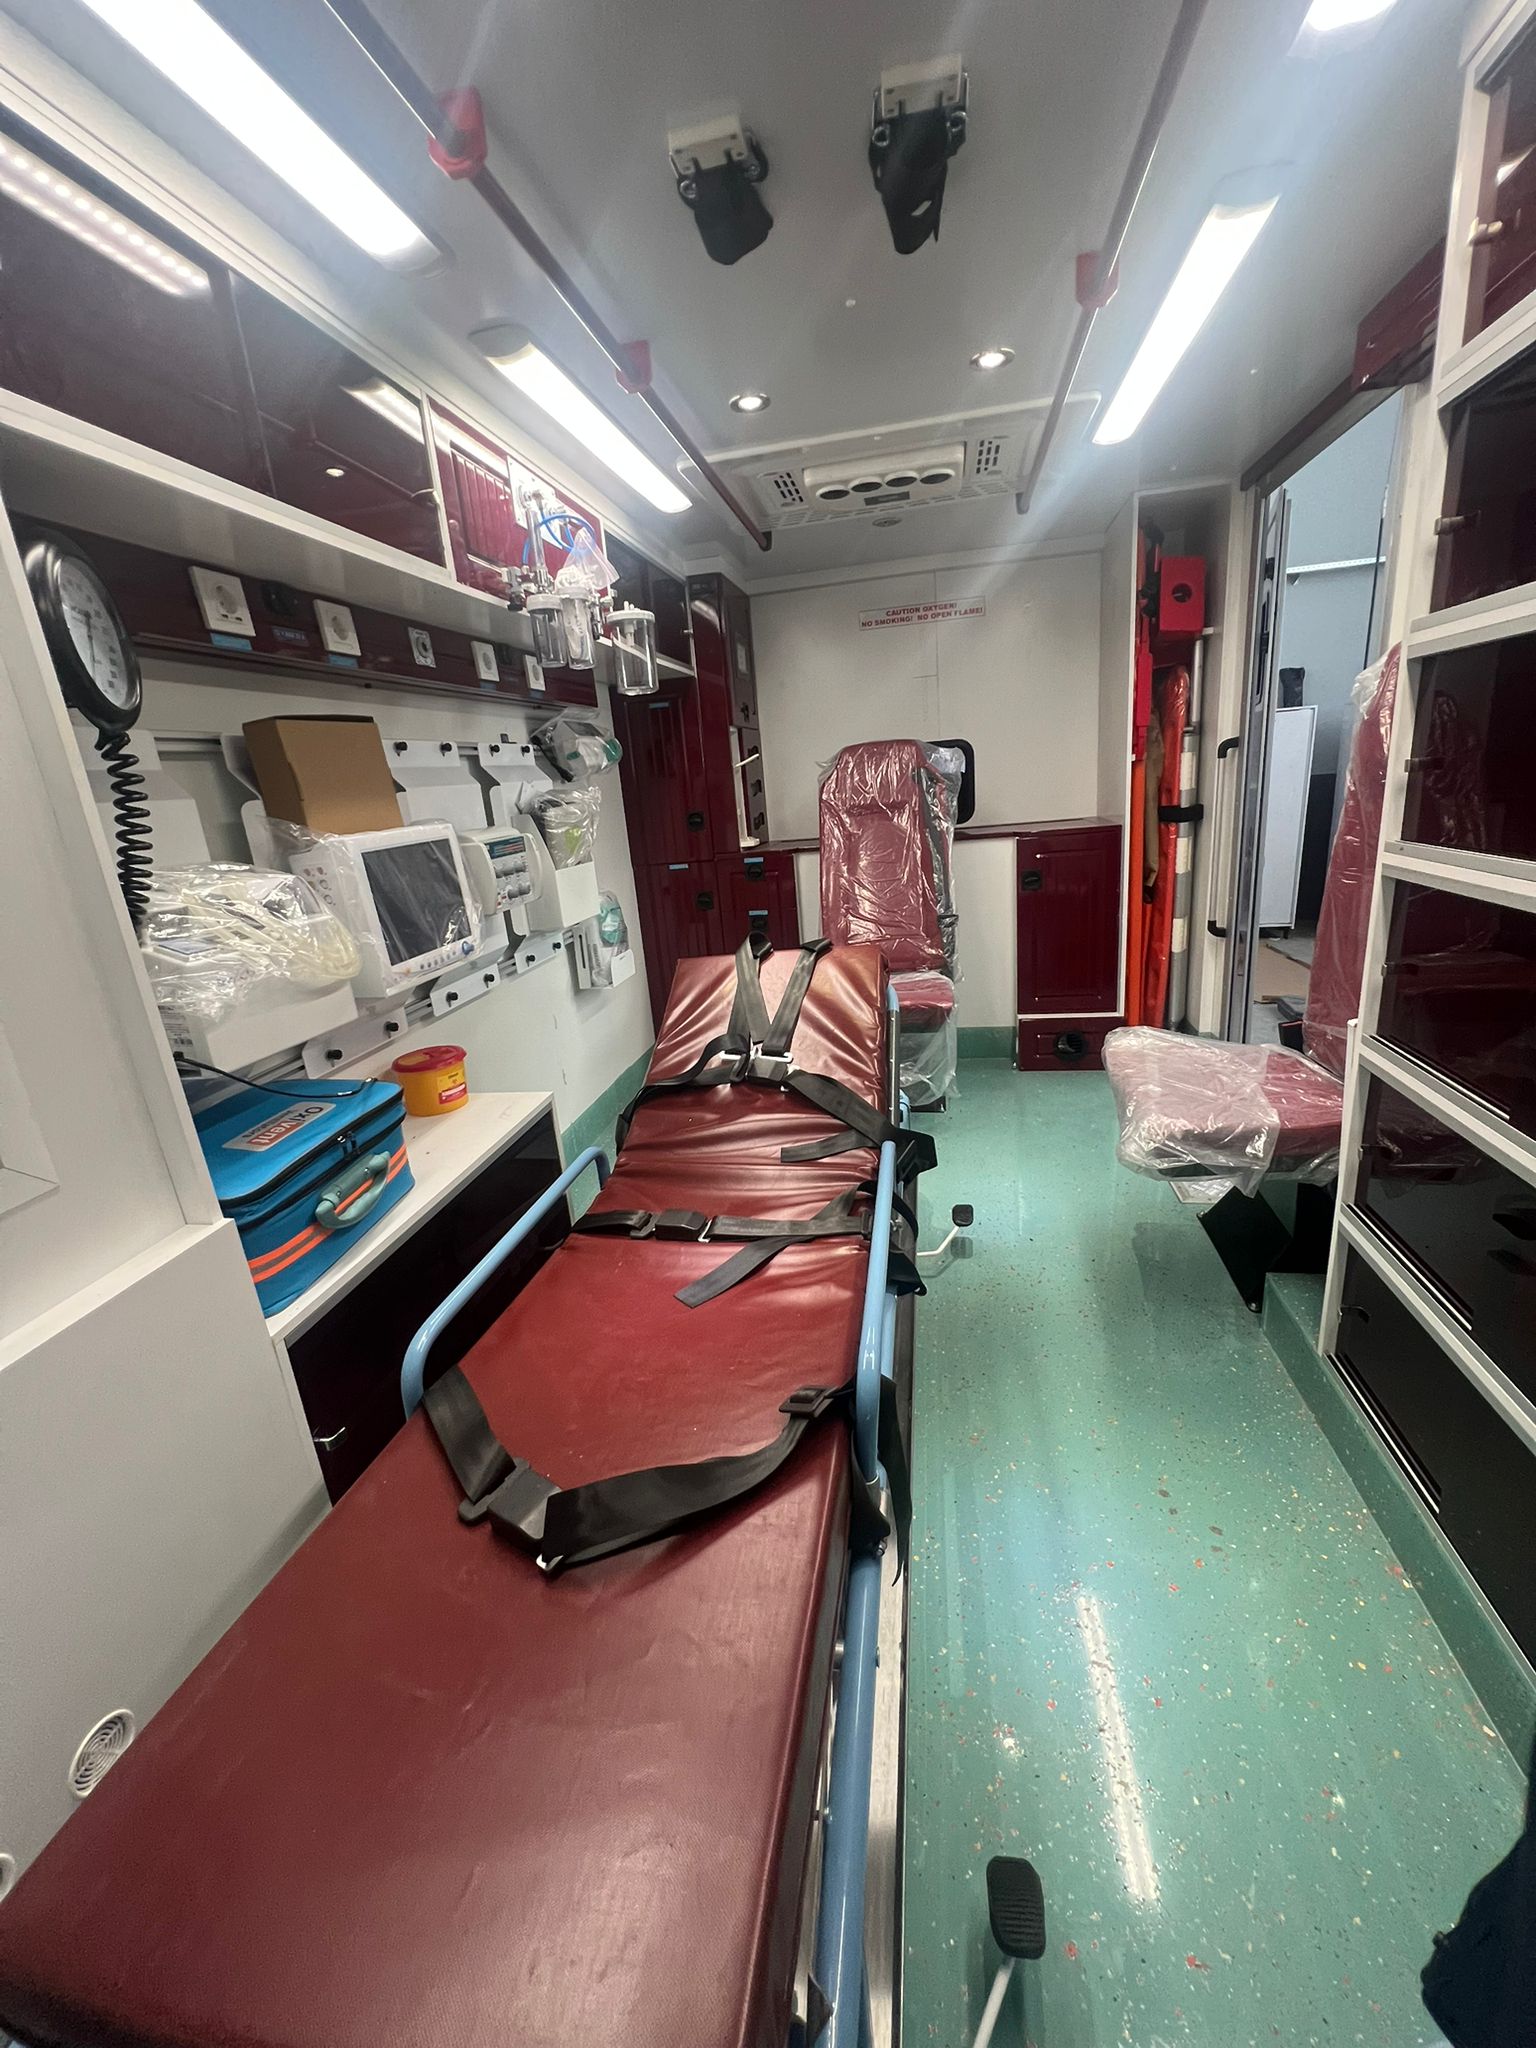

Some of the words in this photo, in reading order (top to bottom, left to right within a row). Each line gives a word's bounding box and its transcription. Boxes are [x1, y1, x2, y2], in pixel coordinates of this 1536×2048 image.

[874, 616, 913, 626] SMOKING!
[931, 610, 952, 619] OPEN
[954, 607, 983, 617] FLAME!
[886, 607, 920, 617] CAUTION
[922, 602, 957, 612] OXYGEN!
